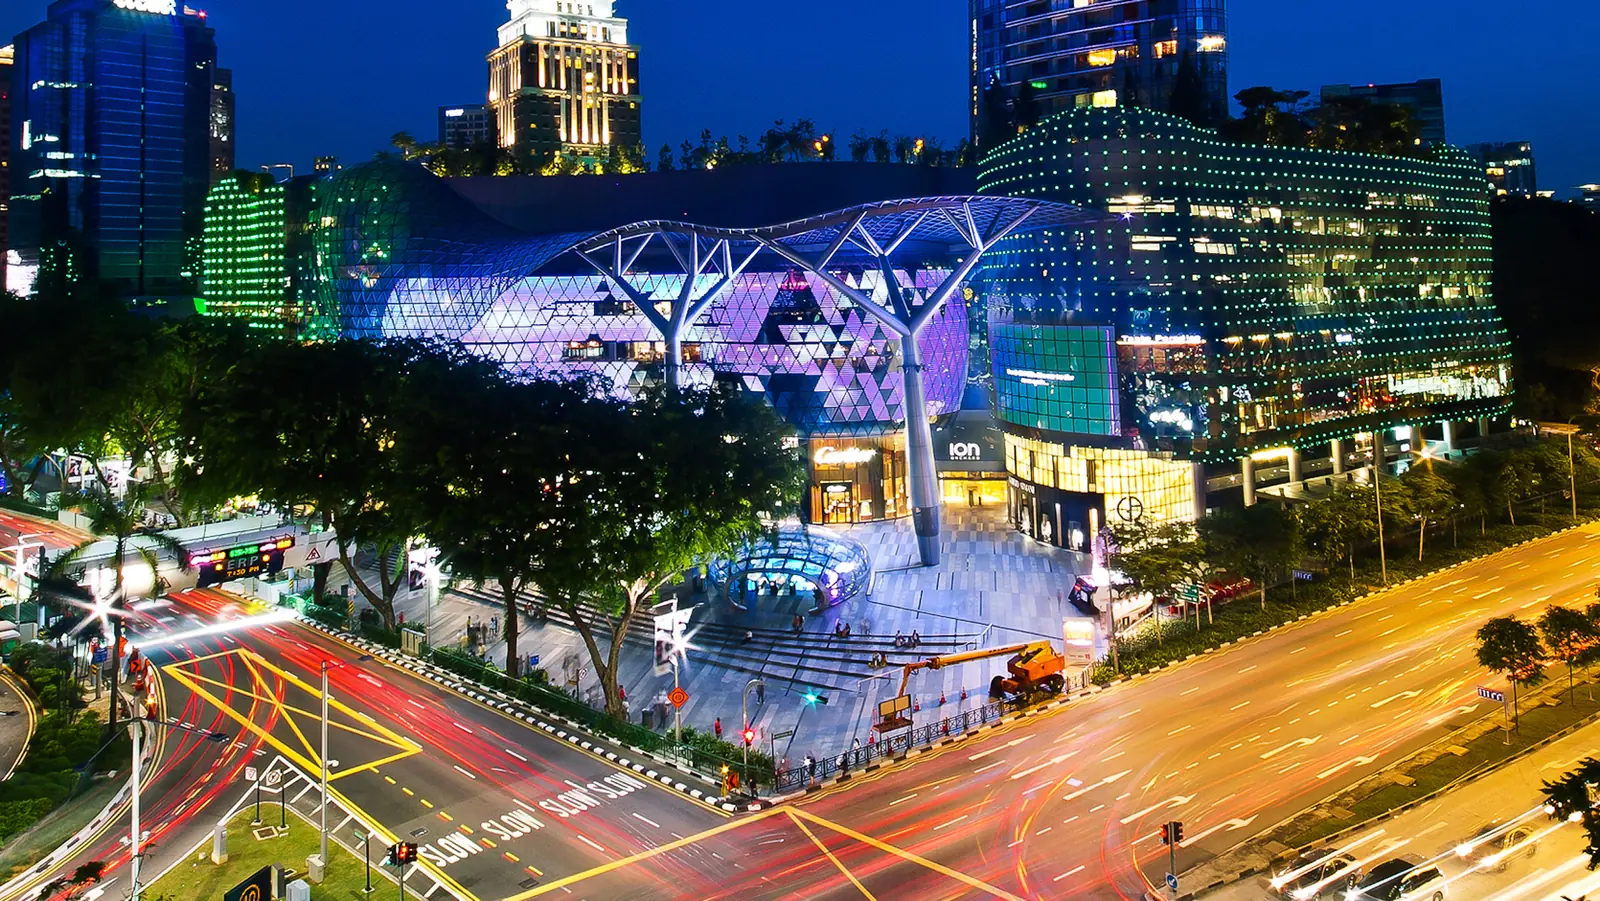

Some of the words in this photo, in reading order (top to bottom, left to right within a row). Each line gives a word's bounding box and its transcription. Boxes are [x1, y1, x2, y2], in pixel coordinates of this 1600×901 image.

[227, 555, 258, 570] ERP
[248, 565, 260, 573] PM
[586, 771, 648, 799] SLOW
[538, 788, 601, 818] SLOW
[480, 808, 545, 841] SLOW
[416, 831, 484, 867] SLOW
